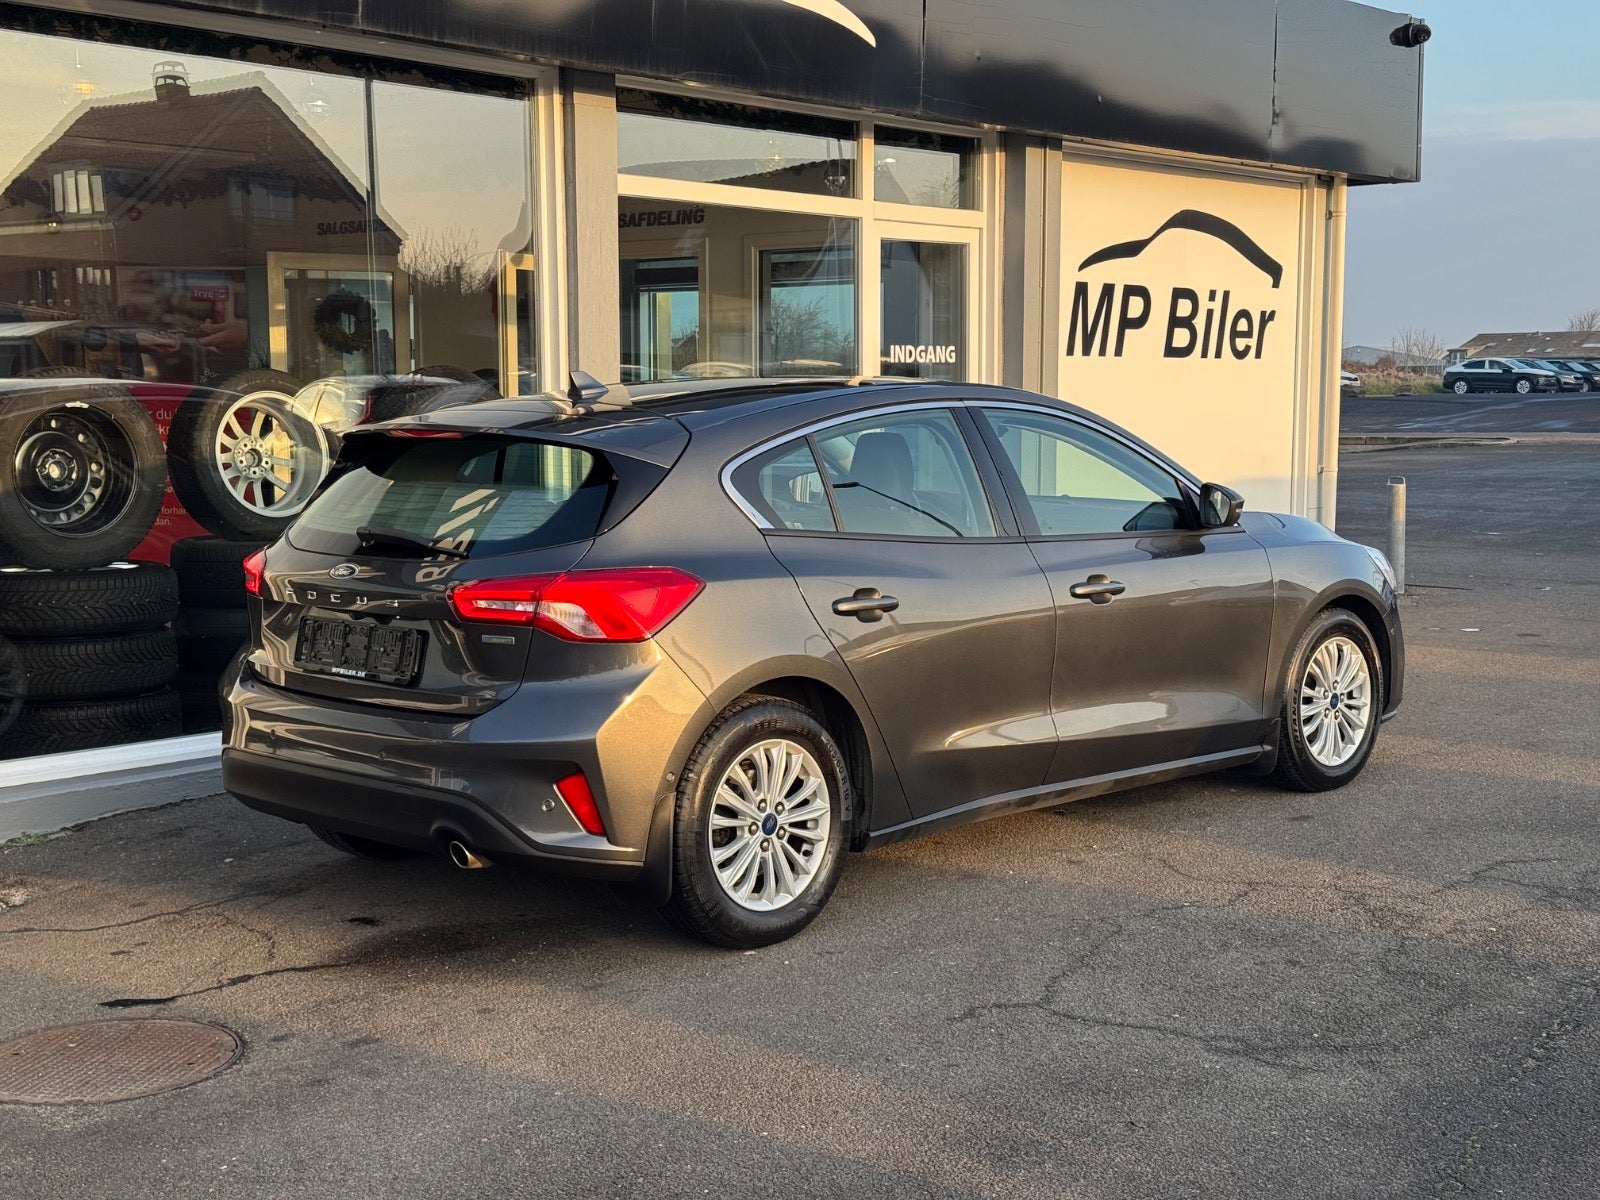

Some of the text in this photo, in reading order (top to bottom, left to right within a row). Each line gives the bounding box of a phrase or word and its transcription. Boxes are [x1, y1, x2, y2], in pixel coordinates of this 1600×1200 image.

[1066, 281, 1277, 360] MP Biler
[890, 344, 956, 363] INDGANG
